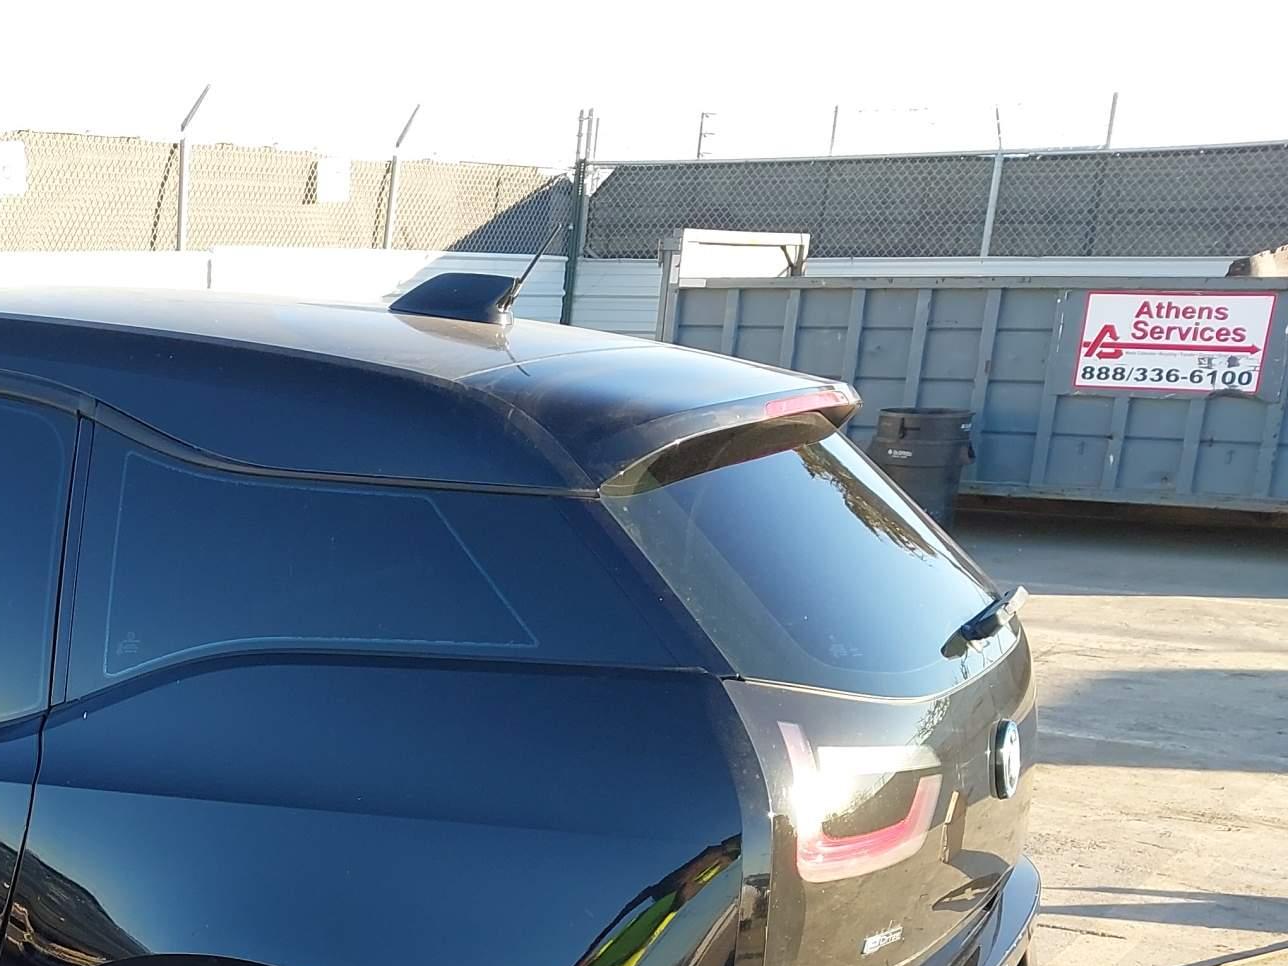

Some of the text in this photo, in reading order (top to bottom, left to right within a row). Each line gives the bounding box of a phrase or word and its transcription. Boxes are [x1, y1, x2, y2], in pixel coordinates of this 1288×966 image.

[1135, 301, 1229, 320] Athens
[1131, 320, 1247, 342] Services
[1081, 366, 1253, 386] 888/336-6100
